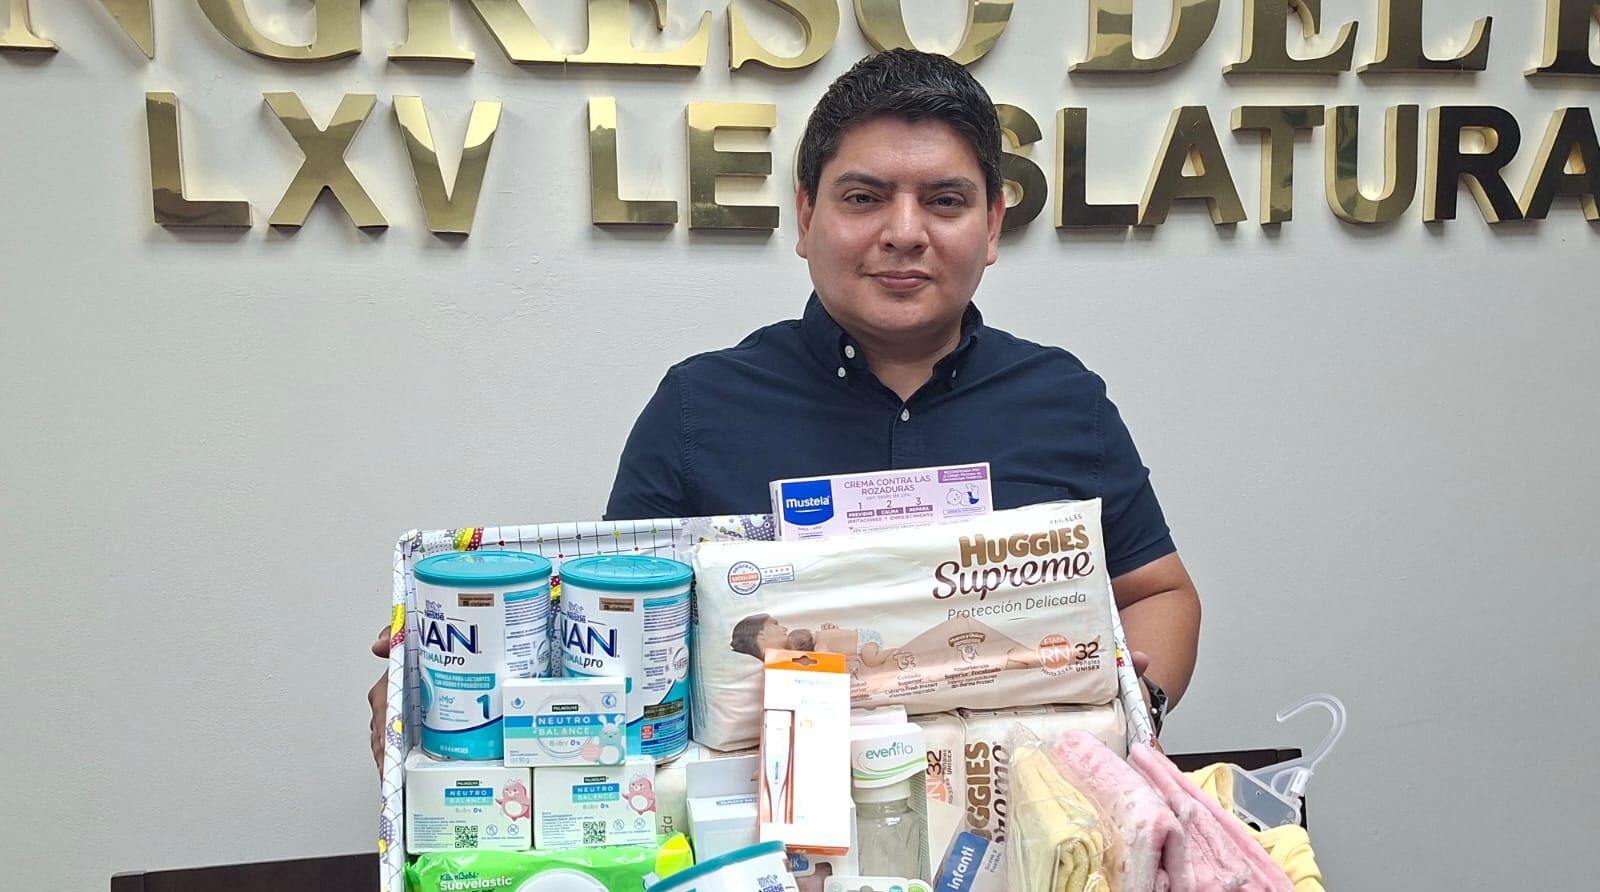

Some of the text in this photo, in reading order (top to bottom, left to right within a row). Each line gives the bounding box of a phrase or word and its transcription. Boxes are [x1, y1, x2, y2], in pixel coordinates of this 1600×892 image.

[145, 91, 1600, 236] LXV LESLATURA
[844, 475, 931, 489] CREMA CONTRA LAS
[862, 485, 915, 496] ROZADURAS
[857, 497, 922, 510] 1 2 3
[958, 524, 1090, 568] HUGGIES
[932, 552, 1095, 601] Supreme
[947, 592, 1087, 620] Protección Delicada
[1040, 646, 1069, 664] RN
[1075, 641, 1099, 660] 32
[476, 694, 491, 720] 1
[538, 716, 591, 725] NEUTRO
[538, 727, 590, 737] BALANCE
[866, 742, 913, 759] evenflo
[927, 749, 942, 776] 32
[946, 845, 975, 890] infanti
[440, 876, 512, 891] Suavelastic
